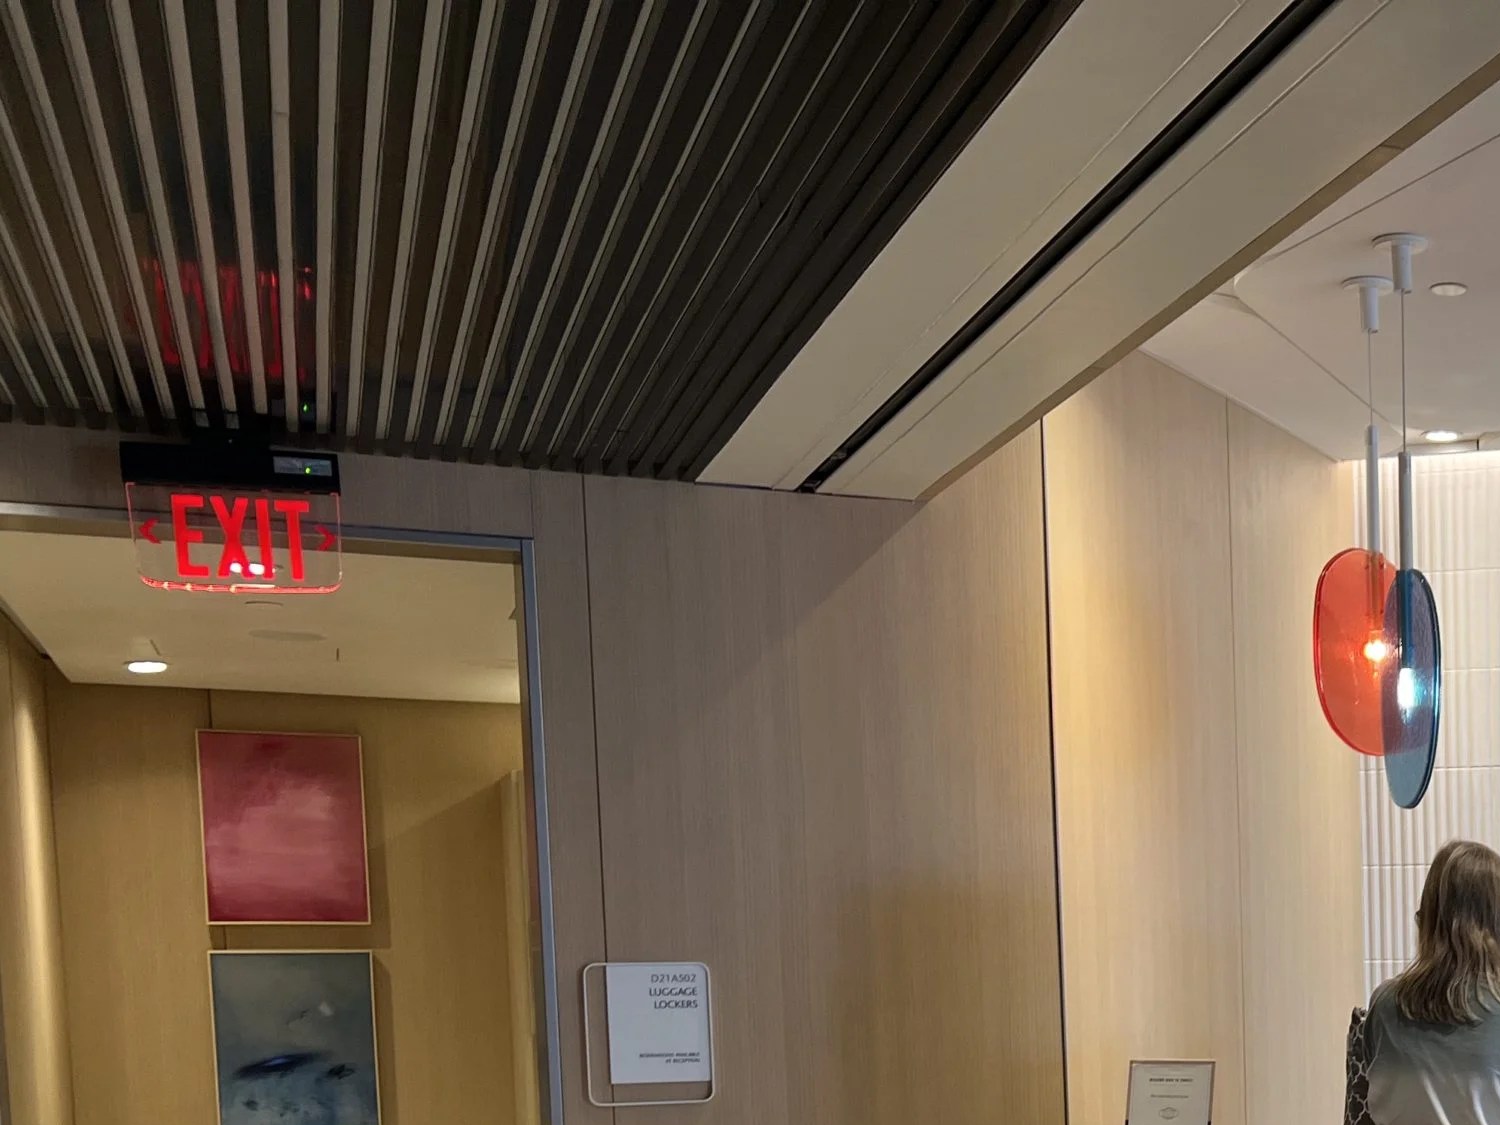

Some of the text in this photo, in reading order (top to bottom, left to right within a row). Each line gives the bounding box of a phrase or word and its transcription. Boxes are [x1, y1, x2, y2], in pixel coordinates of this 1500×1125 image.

[170, 494, 310, 581] EXIT
[649, 986, 698, 997] LUGGAGE
[653, 999, 698, 1010] LOCKERS
